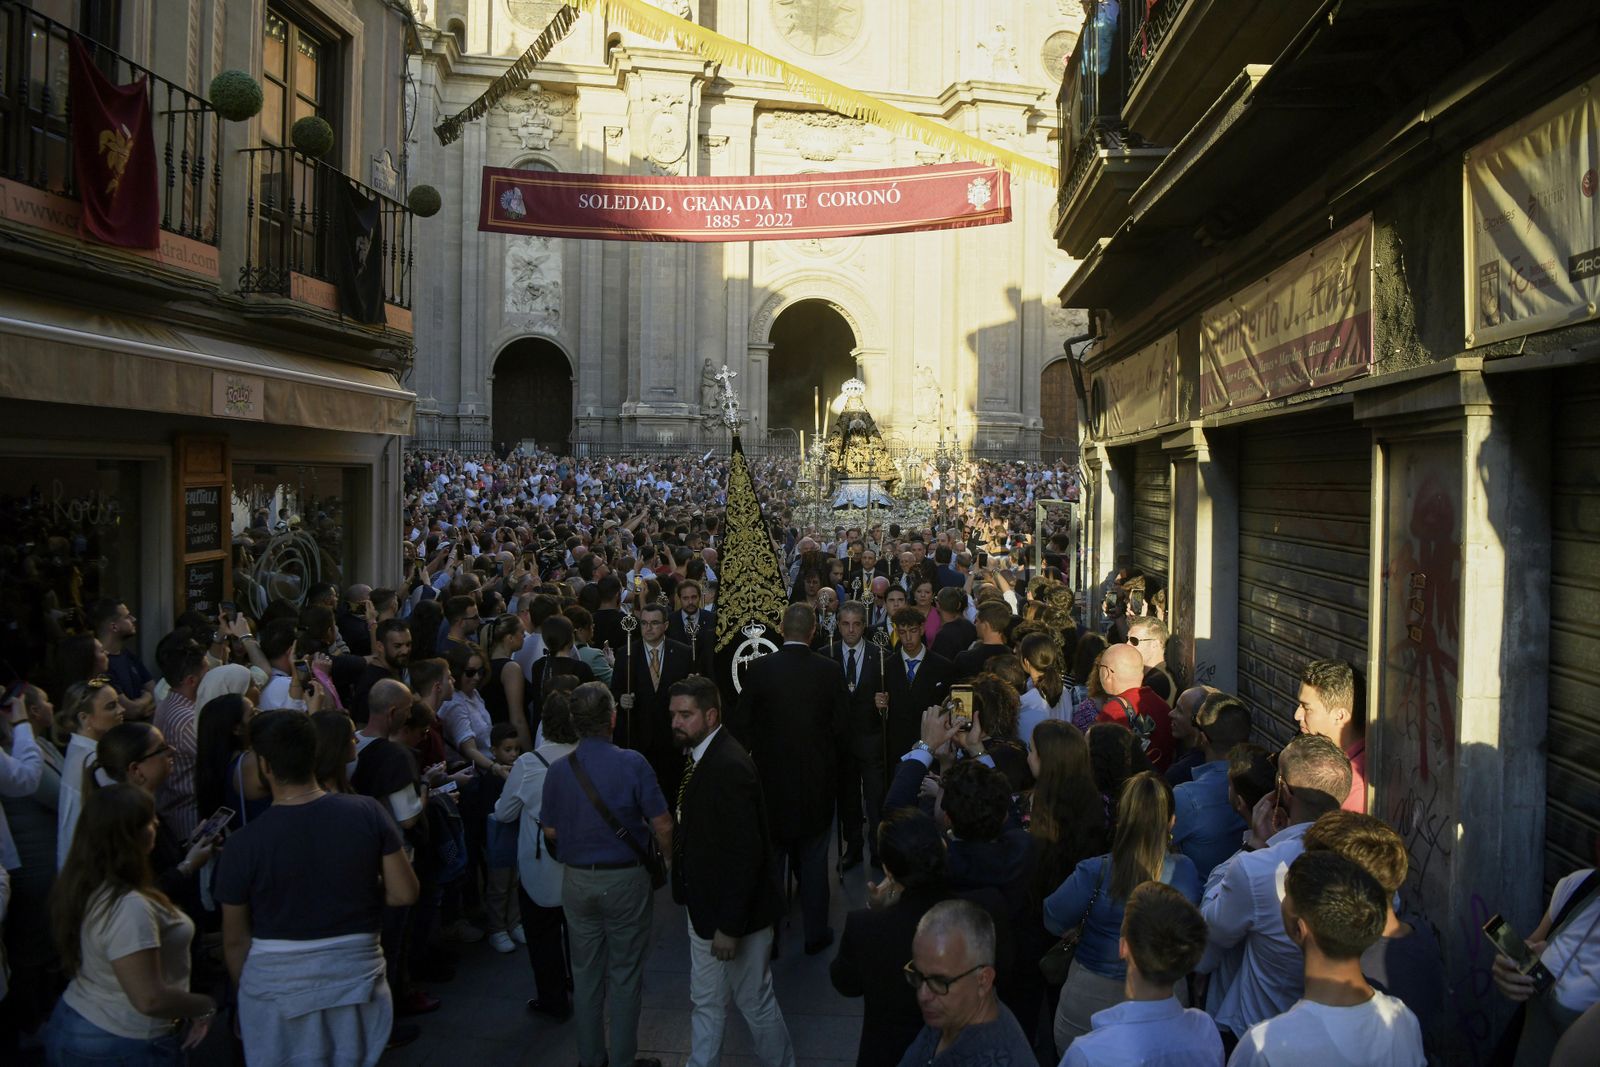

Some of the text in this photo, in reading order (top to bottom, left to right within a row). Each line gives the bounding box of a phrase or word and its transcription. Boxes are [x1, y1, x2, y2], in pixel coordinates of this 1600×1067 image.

[579, 182, 901, 214] SOLEDAD, GRANADA TE CORONÓ
[704, 213, 740, 228] 1885
[755, 213, 793, 227] 2022
